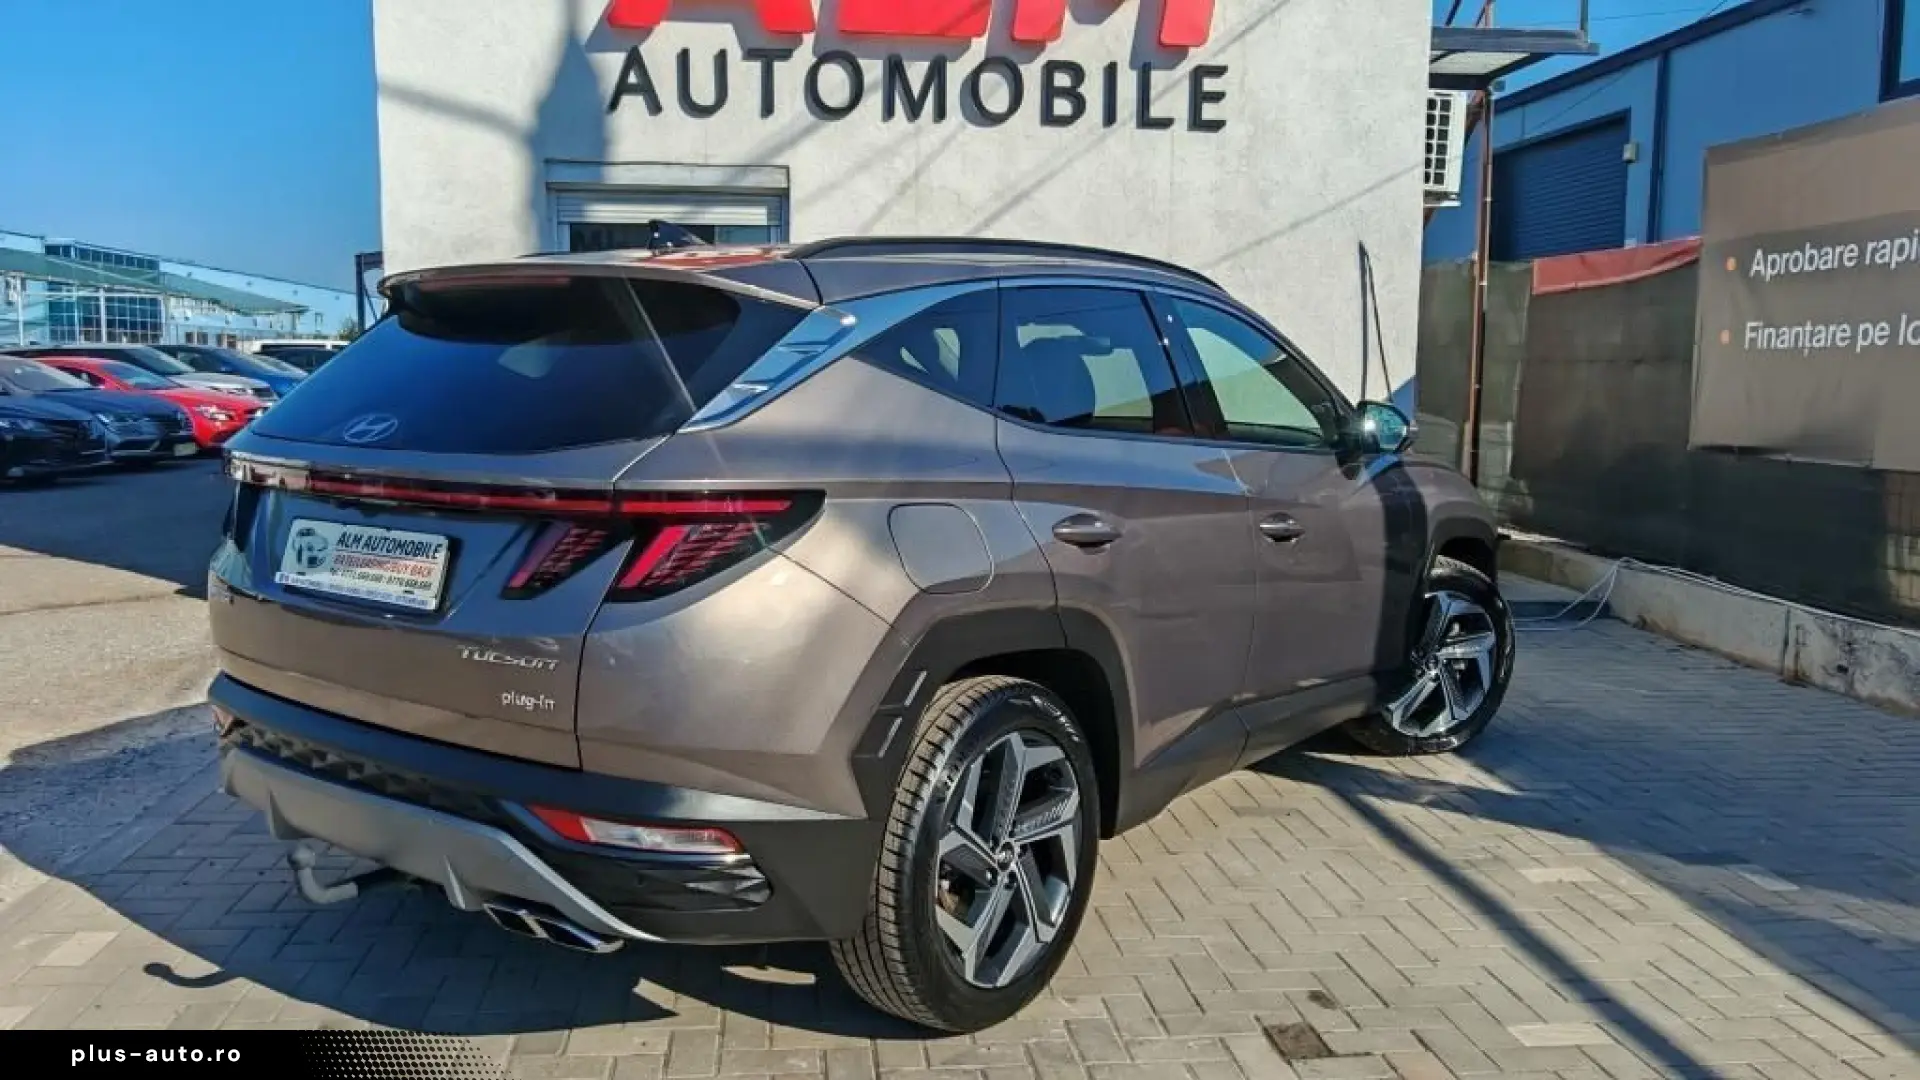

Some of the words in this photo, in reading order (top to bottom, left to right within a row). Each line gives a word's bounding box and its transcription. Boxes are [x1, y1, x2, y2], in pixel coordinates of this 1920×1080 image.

[607, 45, 1229, 131] AUTOMOBILE
[1749, 242, 1859, 281] Aprobare
[1744, 320, 1851, 357] Finanțare
[1856, 321, 1890, 353] pe
[336, 531, 363, 549] ALM
[362, 536, 443, 559] AUTOMOBILE
[457, 645, 559, 670] TUCSON
[502, 691, 556, 711] plug-in
